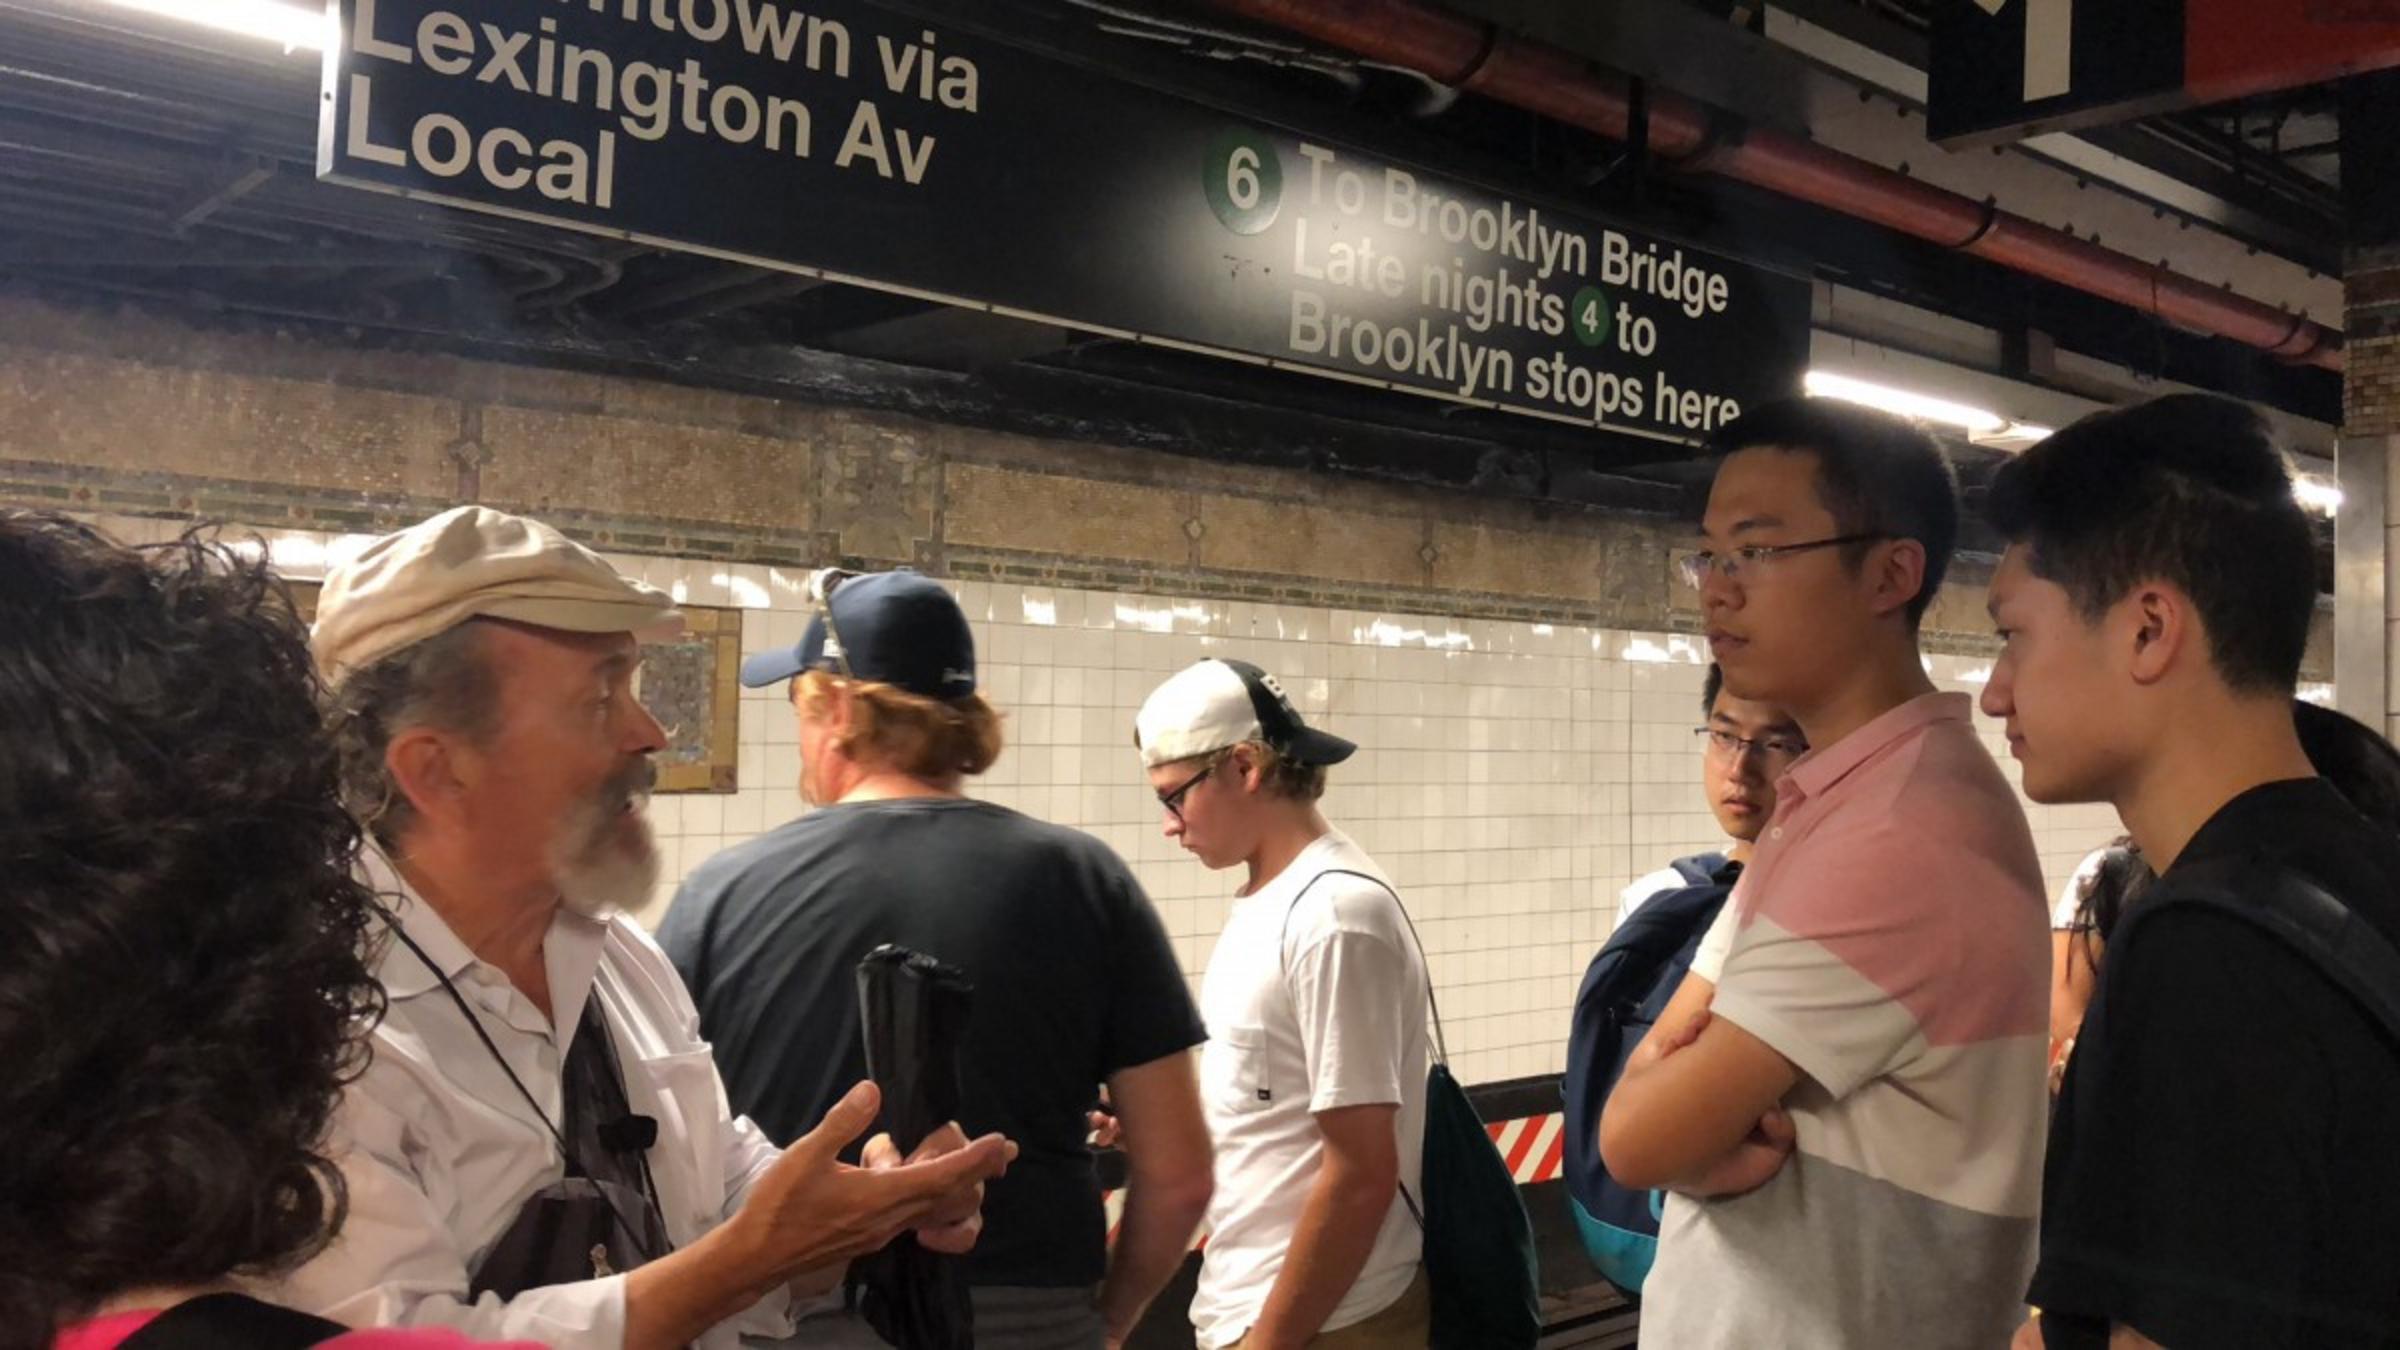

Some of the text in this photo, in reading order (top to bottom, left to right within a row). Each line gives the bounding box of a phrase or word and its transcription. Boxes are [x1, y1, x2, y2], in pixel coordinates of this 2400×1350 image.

[352, 0, 935, 185] Lexington Av
[877, 31, 979, 112] via
[347, 73, 615, 209] Local
[1226, 147, 1261, 209] 6
[1294, 218, 1656, 356] Late nights 4 to
[1301, 143, 1729, 318] To Brooklyn Bridge
[1289, 291, 1513, 397] Brooklyn
[1526, 350, 1643, 422] stops
